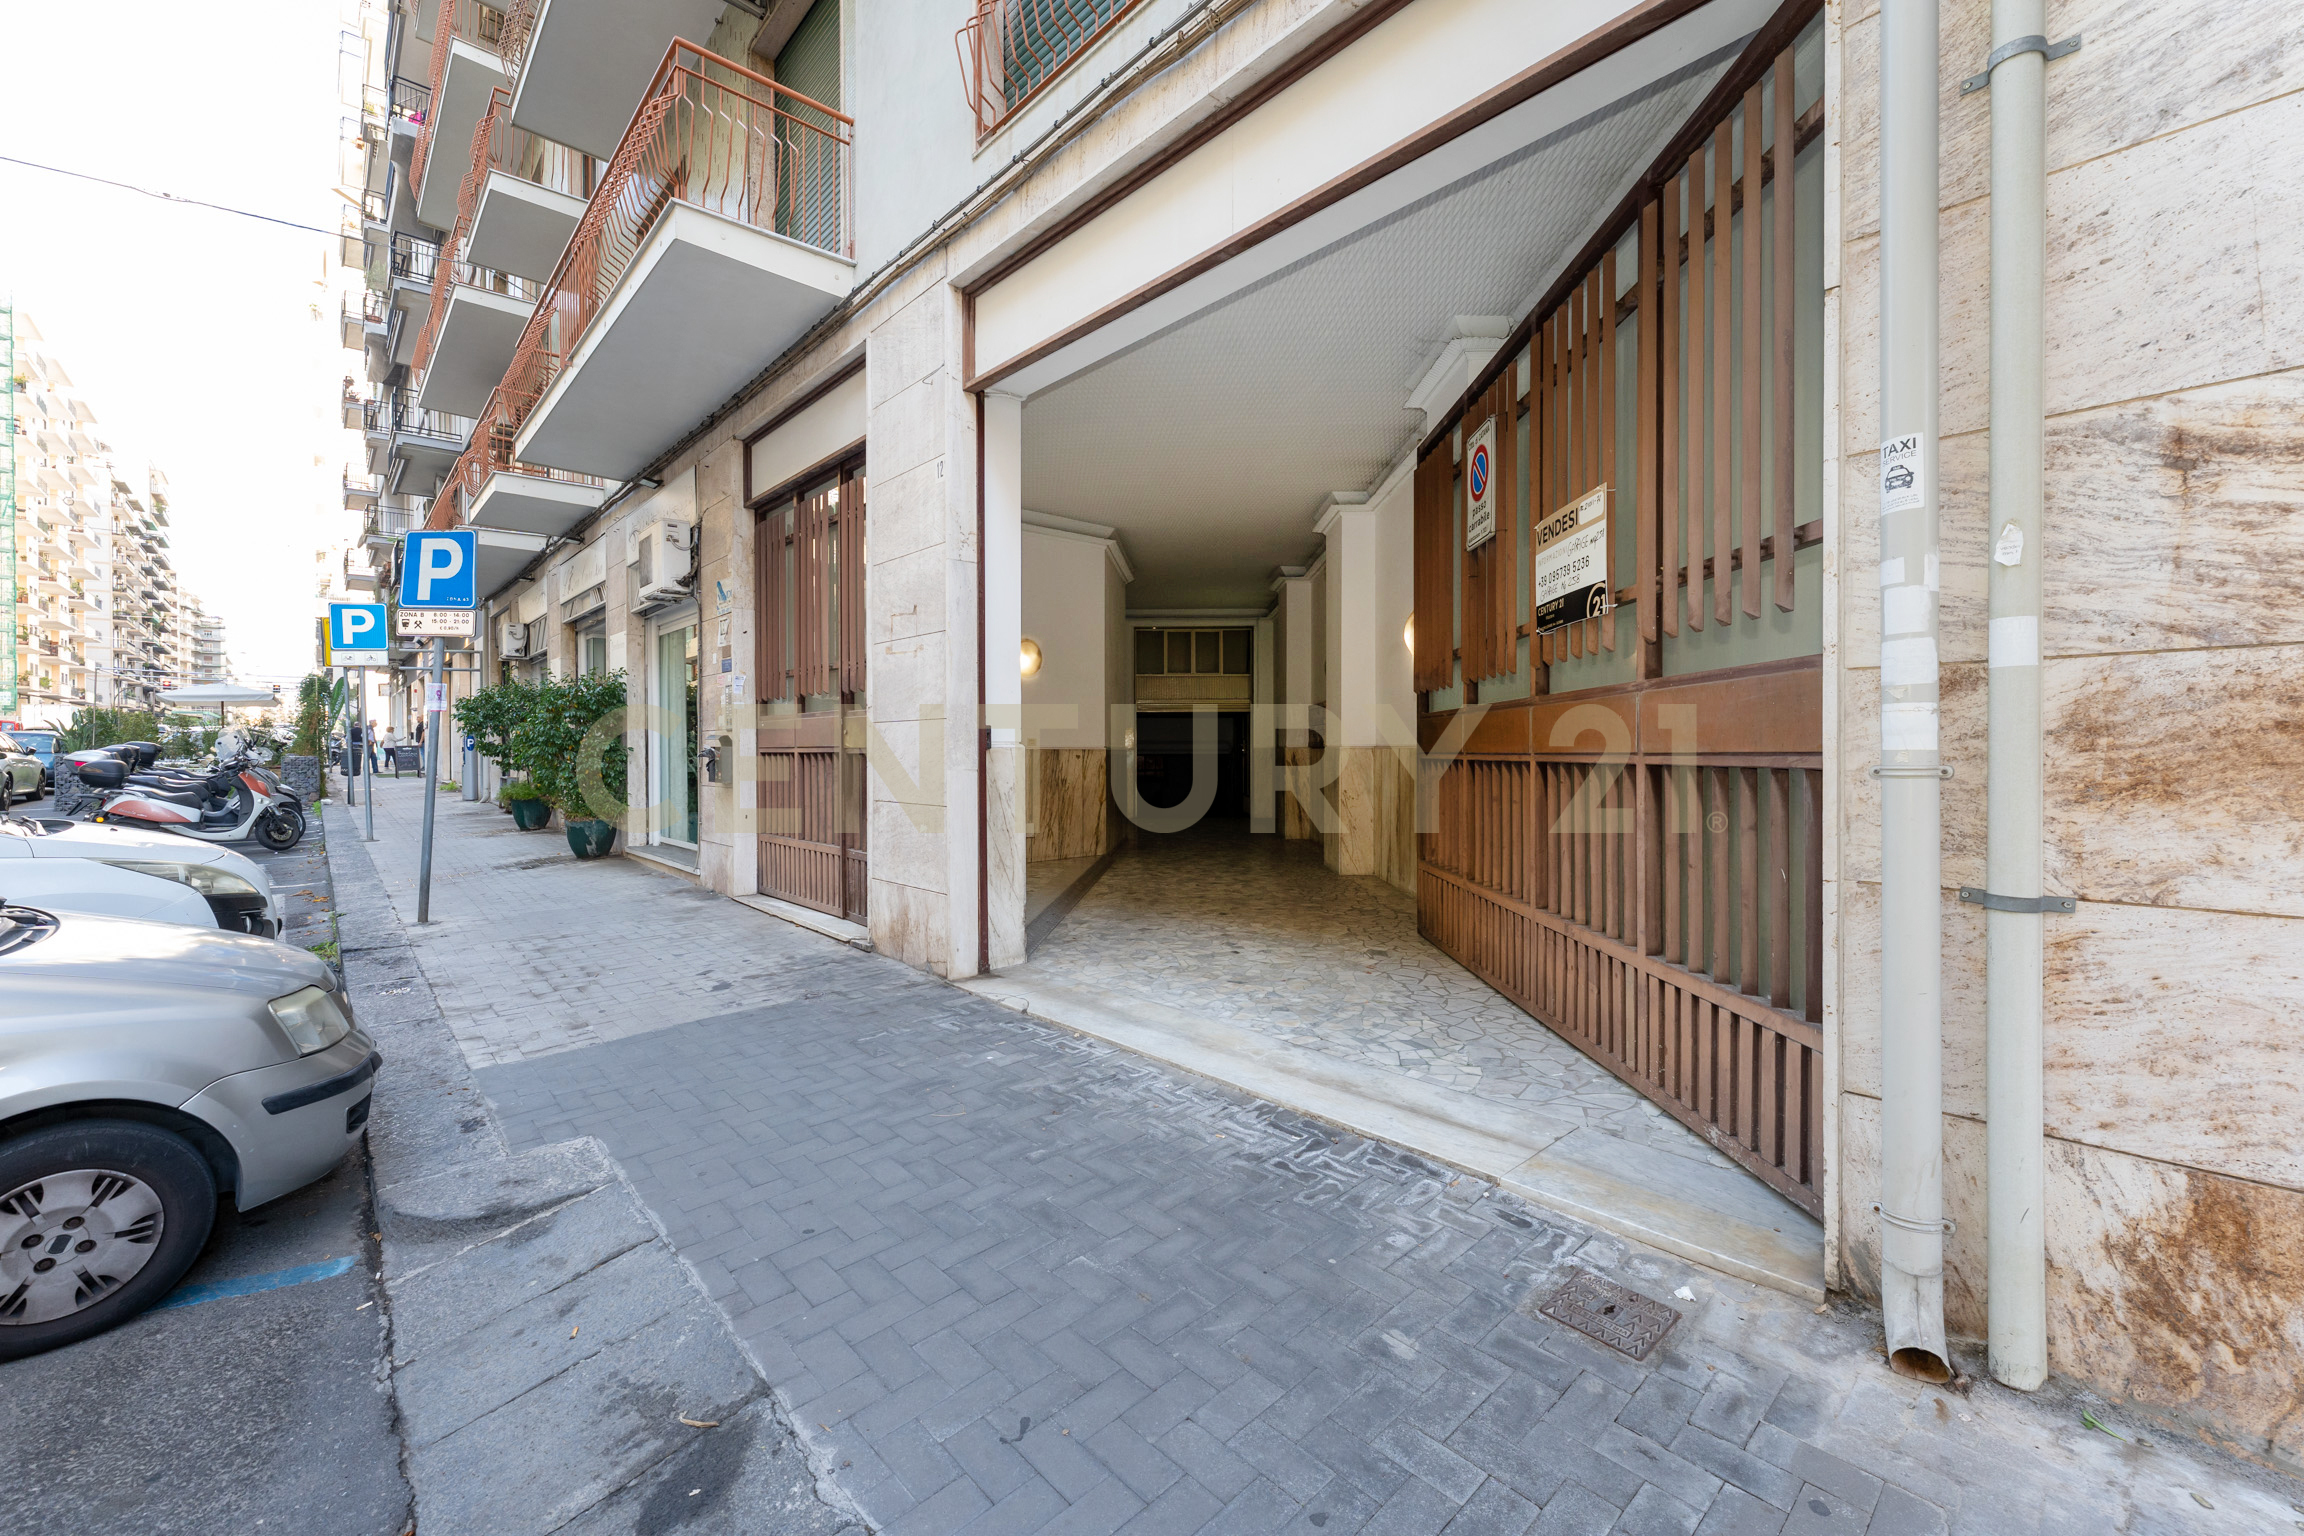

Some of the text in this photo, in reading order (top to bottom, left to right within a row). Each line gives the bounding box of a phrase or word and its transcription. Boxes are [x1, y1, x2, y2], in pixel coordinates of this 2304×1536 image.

[1883, 437, 1916, 459] TAXI
[1883, 449, 1917, 467] SERVICE
[1472, 500, 1486, 520] passo
[1468, 511, 1490, 532] carrabile
[1537, 507, 1578, 546] VENDESI
[417, 538, 463, 600] P
[1572, 555, 1590, 573] 5236
[1537, 600, 1559, 617] CENTURY
[342, 609, 375, 645] P
[467, 738, 475, 748] P
